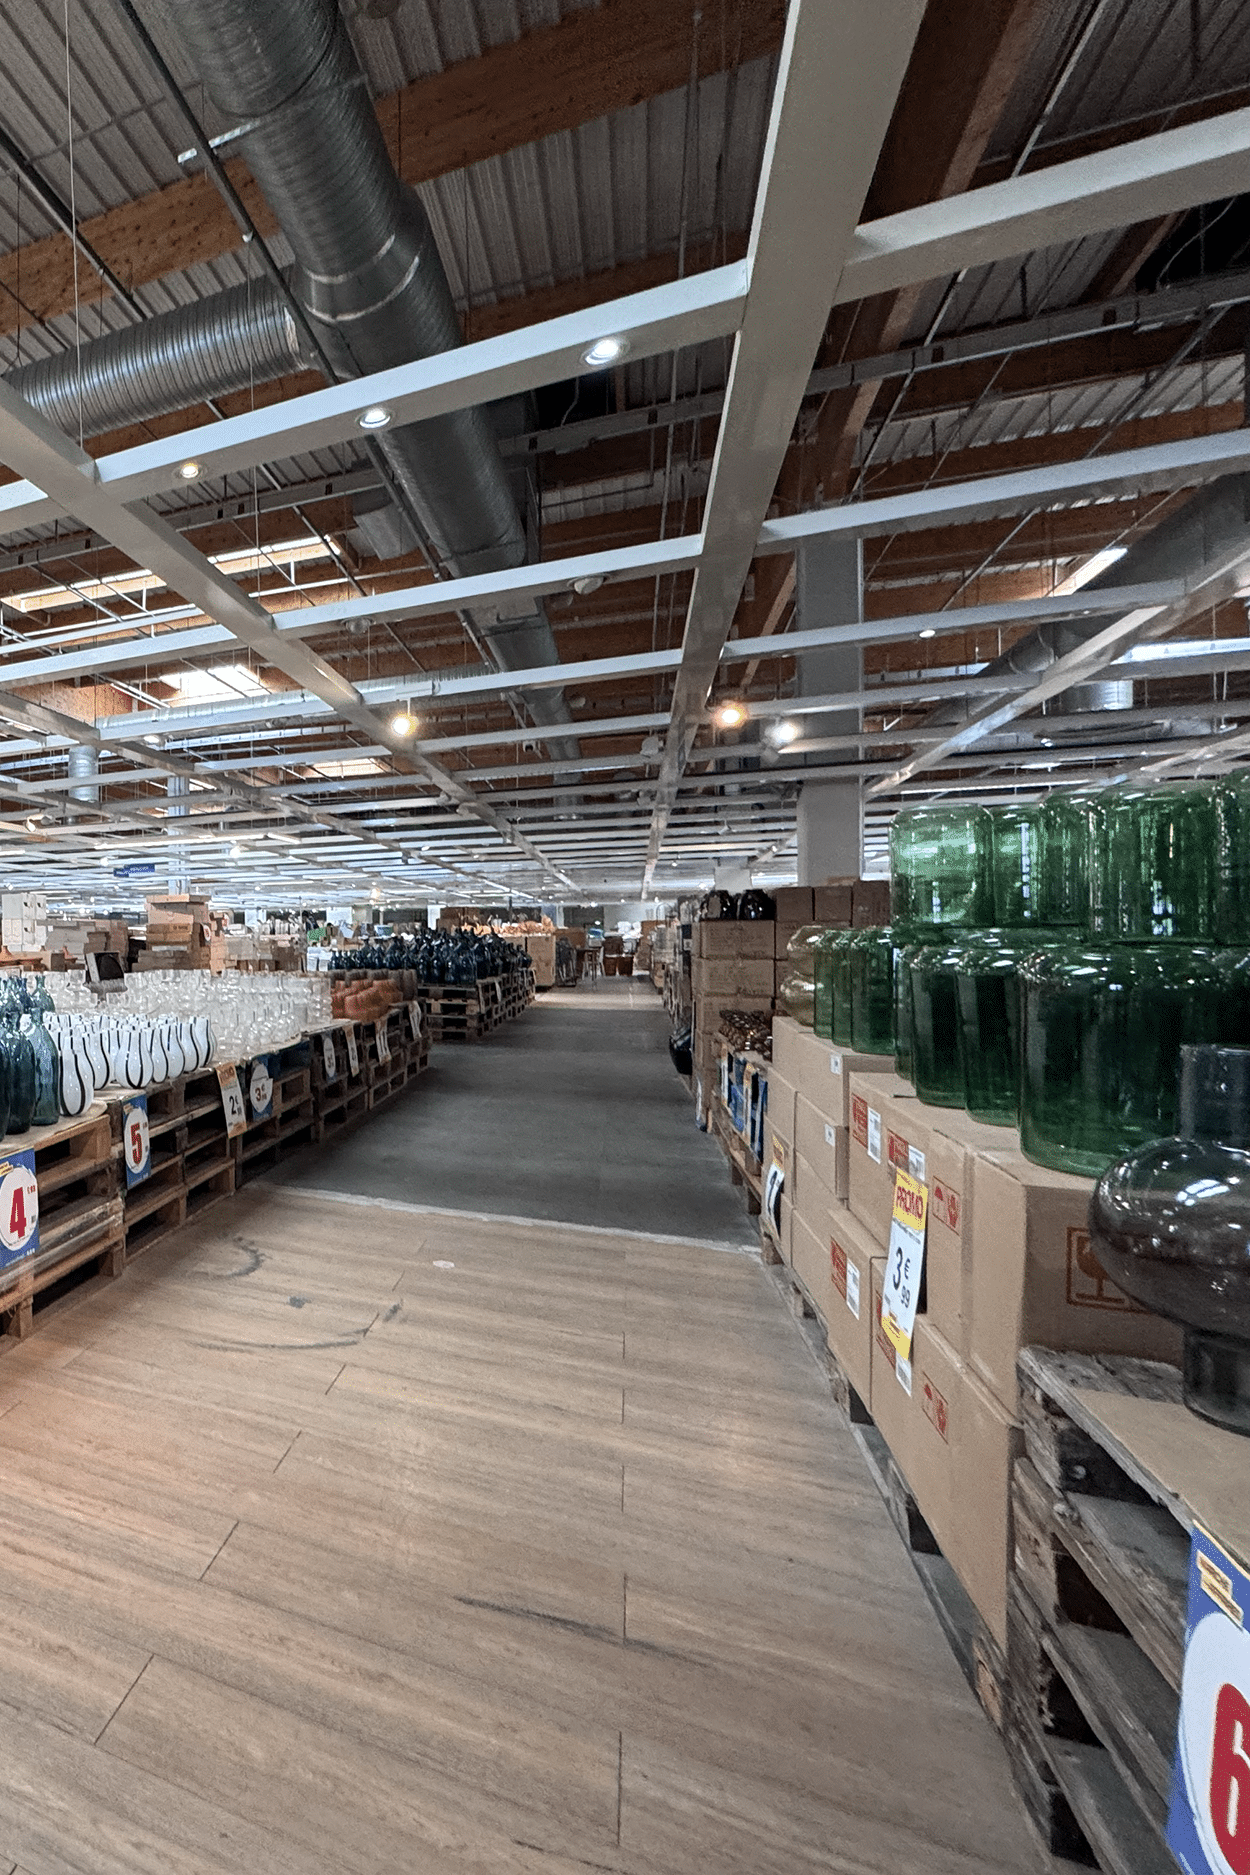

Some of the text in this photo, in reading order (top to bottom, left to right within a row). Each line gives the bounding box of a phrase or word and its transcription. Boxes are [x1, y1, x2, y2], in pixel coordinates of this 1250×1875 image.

[229, 1095, 236, 1115] 2
[255, 1087, 261, 1101] 3
[130, 1122, 142, 1164] 5
[10, 1186, 27, 1239] 4
[896, 1185, 924, 1220] PROMO
[893, 1246, 904, 1291] 3
